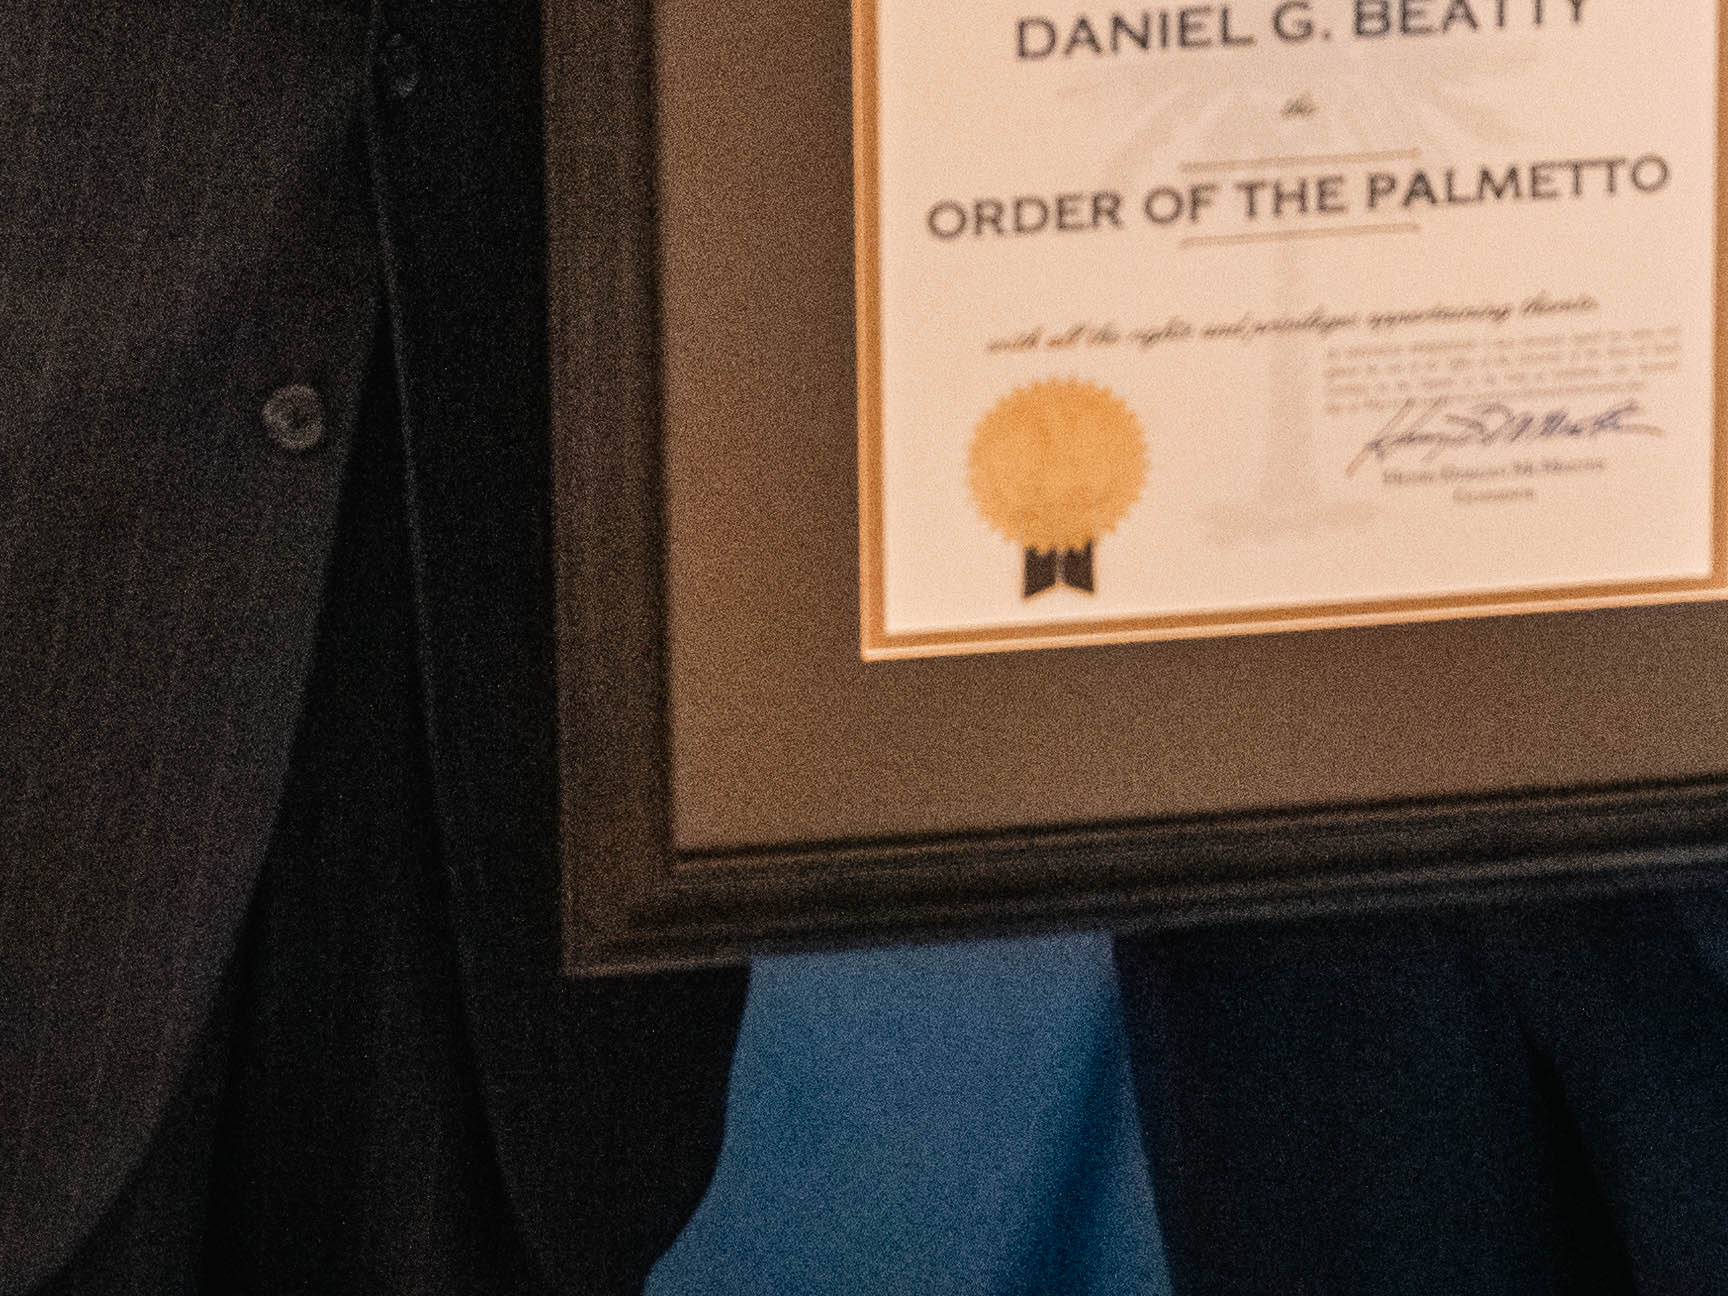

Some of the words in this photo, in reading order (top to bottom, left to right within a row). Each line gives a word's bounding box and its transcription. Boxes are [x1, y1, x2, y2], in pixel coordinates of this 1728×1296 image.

[1016, 2, 1257, 61] DANIEL
[926, 188, 1125, 241] ORDER
[1142, 181, 1219, 225] OF
[1233, 172, 1348, 222] THE
[1367, 153, 1670, 210] PALMETTO
